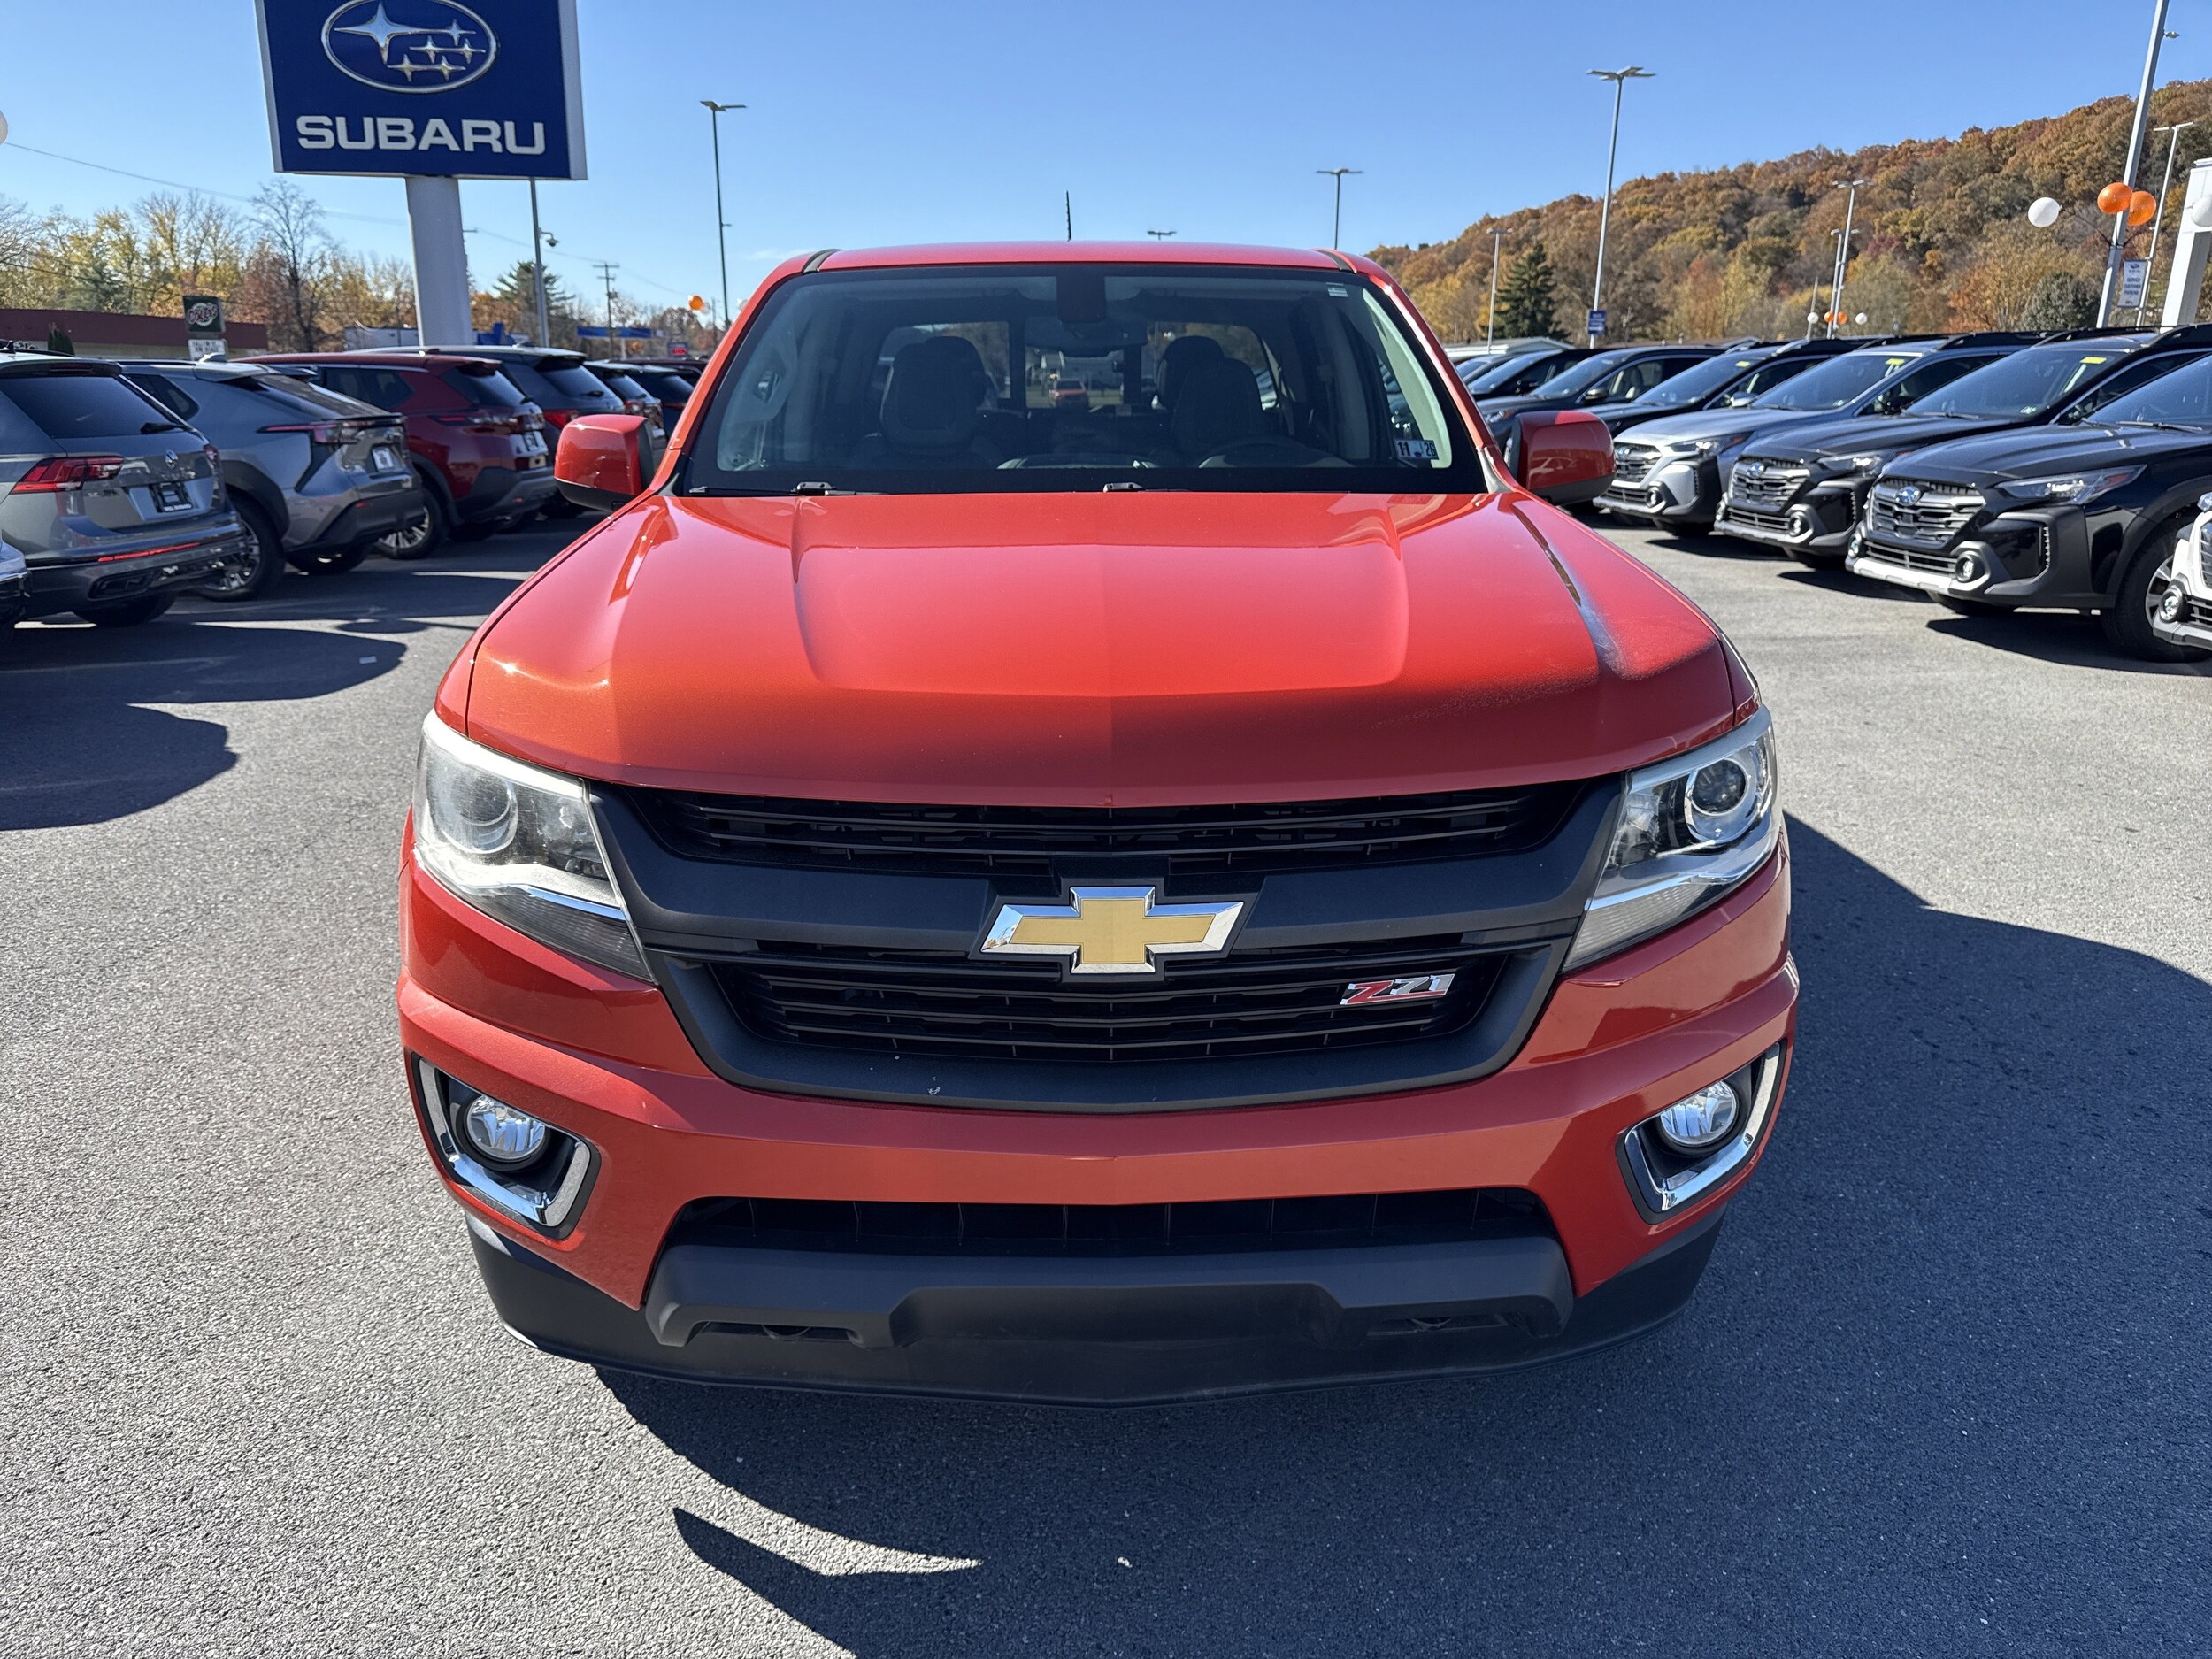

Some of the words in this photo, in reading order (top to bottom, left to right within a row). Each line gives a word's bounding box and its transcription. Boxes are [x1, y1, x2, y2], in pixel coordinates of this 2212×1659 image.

[296, 115, 546, 156] SUBARU
[1397, 442, 1411, 457] 11
[1424, 442, 1437, 457] 26
[1340, 973, 1455, 1005] Z71
